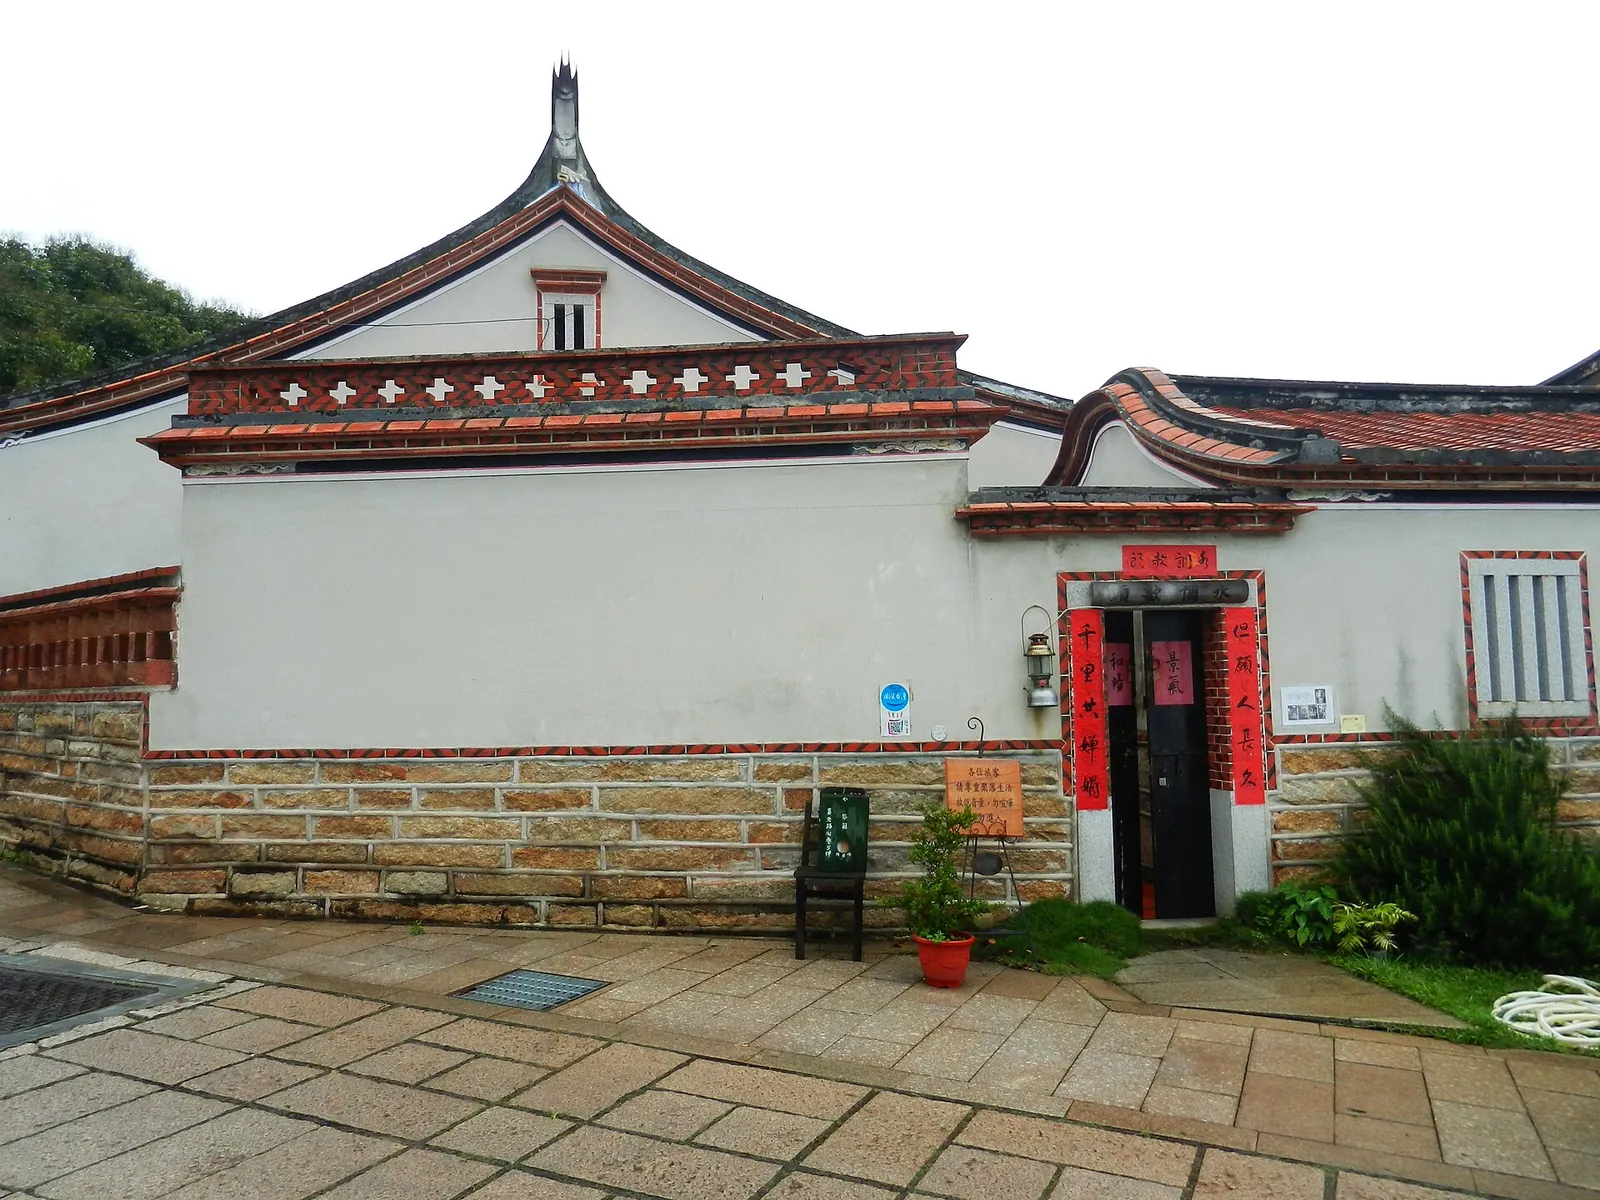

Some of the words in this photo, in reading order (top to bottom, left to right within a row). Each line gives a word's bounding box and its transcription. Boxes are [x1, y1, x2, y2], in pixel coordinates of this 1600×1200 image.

[1077, 623, 1100, 799] 千里共嬋娟
[1164, 651, 1184, 697] 景氣
[1233, 622, 1257, 787] 但願人長久
[967, 766, 1000, 777] 各位旅客
